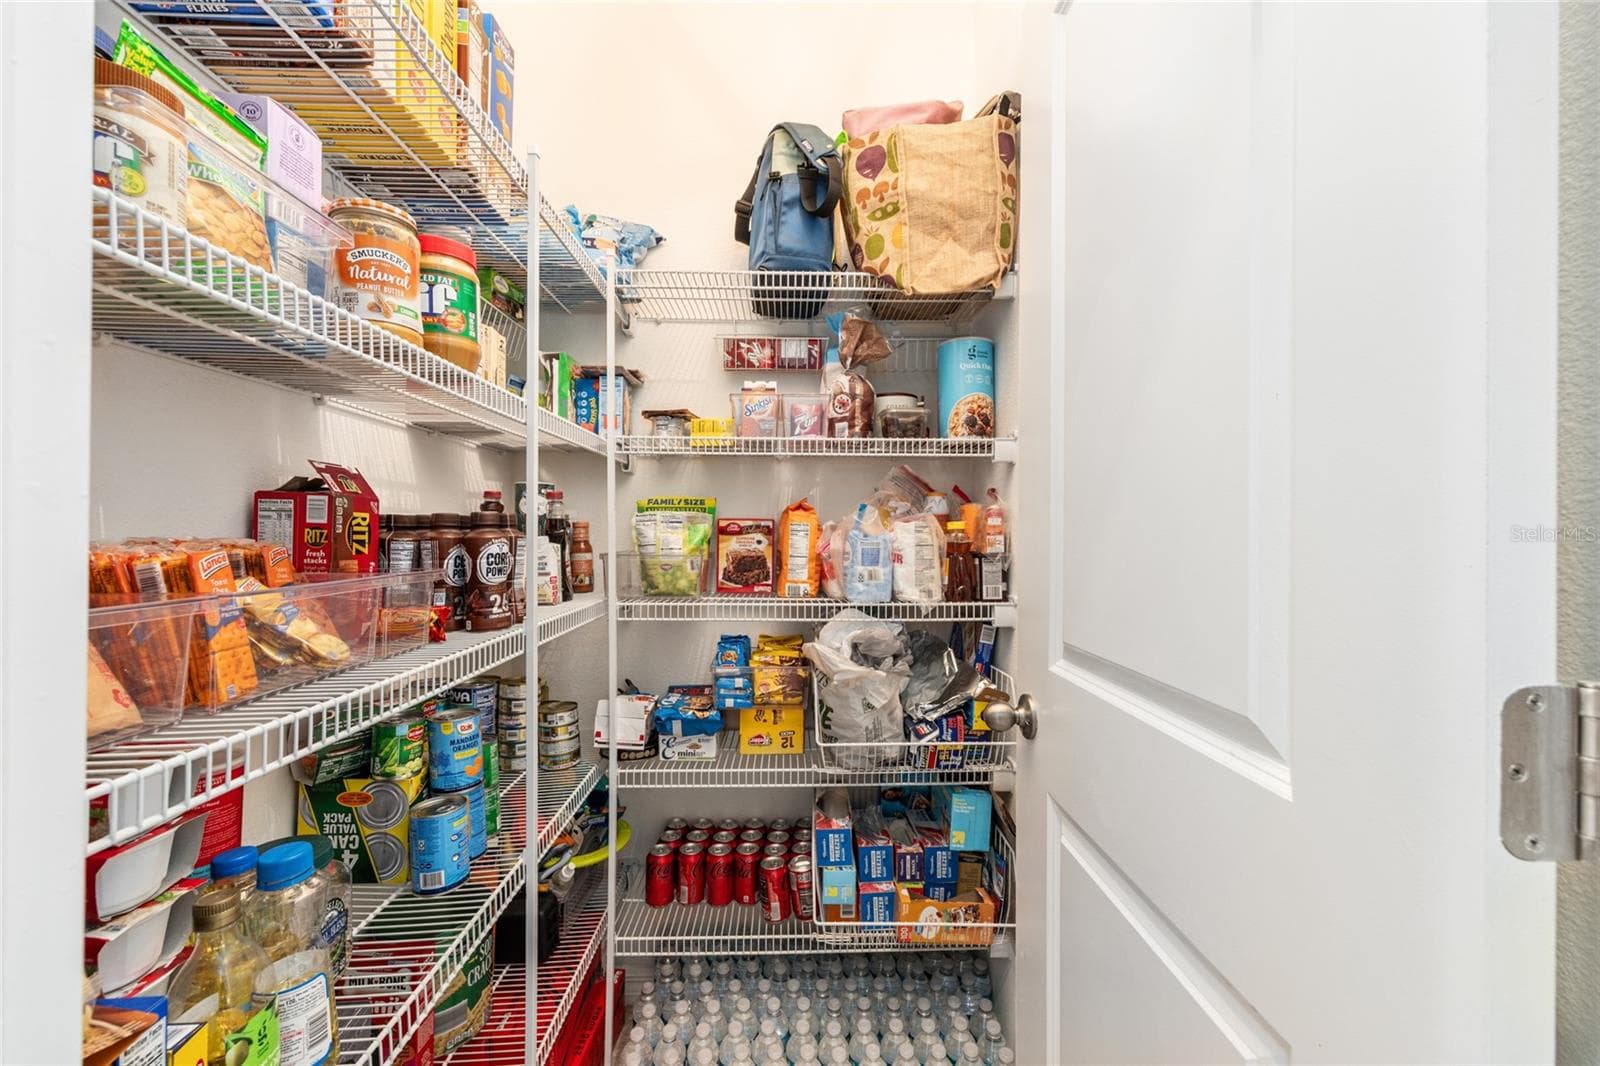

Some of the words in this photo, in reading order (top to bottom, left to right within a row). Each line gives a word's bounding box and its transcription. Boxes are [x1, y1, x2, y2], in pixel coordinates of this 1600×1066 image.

[187, 4, 229, 13] FLAKES
[349, 264, 410, 290] Natural
[744, 398, 773, 417] Sunkist
[647, 498, 681, 506] FAMILY
[684, 498, 706, 506] SIZE
[304, 527, 329, 544] RITZ
[352, 511, 370, 555] RITZ
[305, 549, 326, 557] fresh
[781, 737, 795, 749] 12
[323, 812, 352, 823] PACK
[322, 823, 357, 834] VALUE
[341, 850, 360, 870] 4
